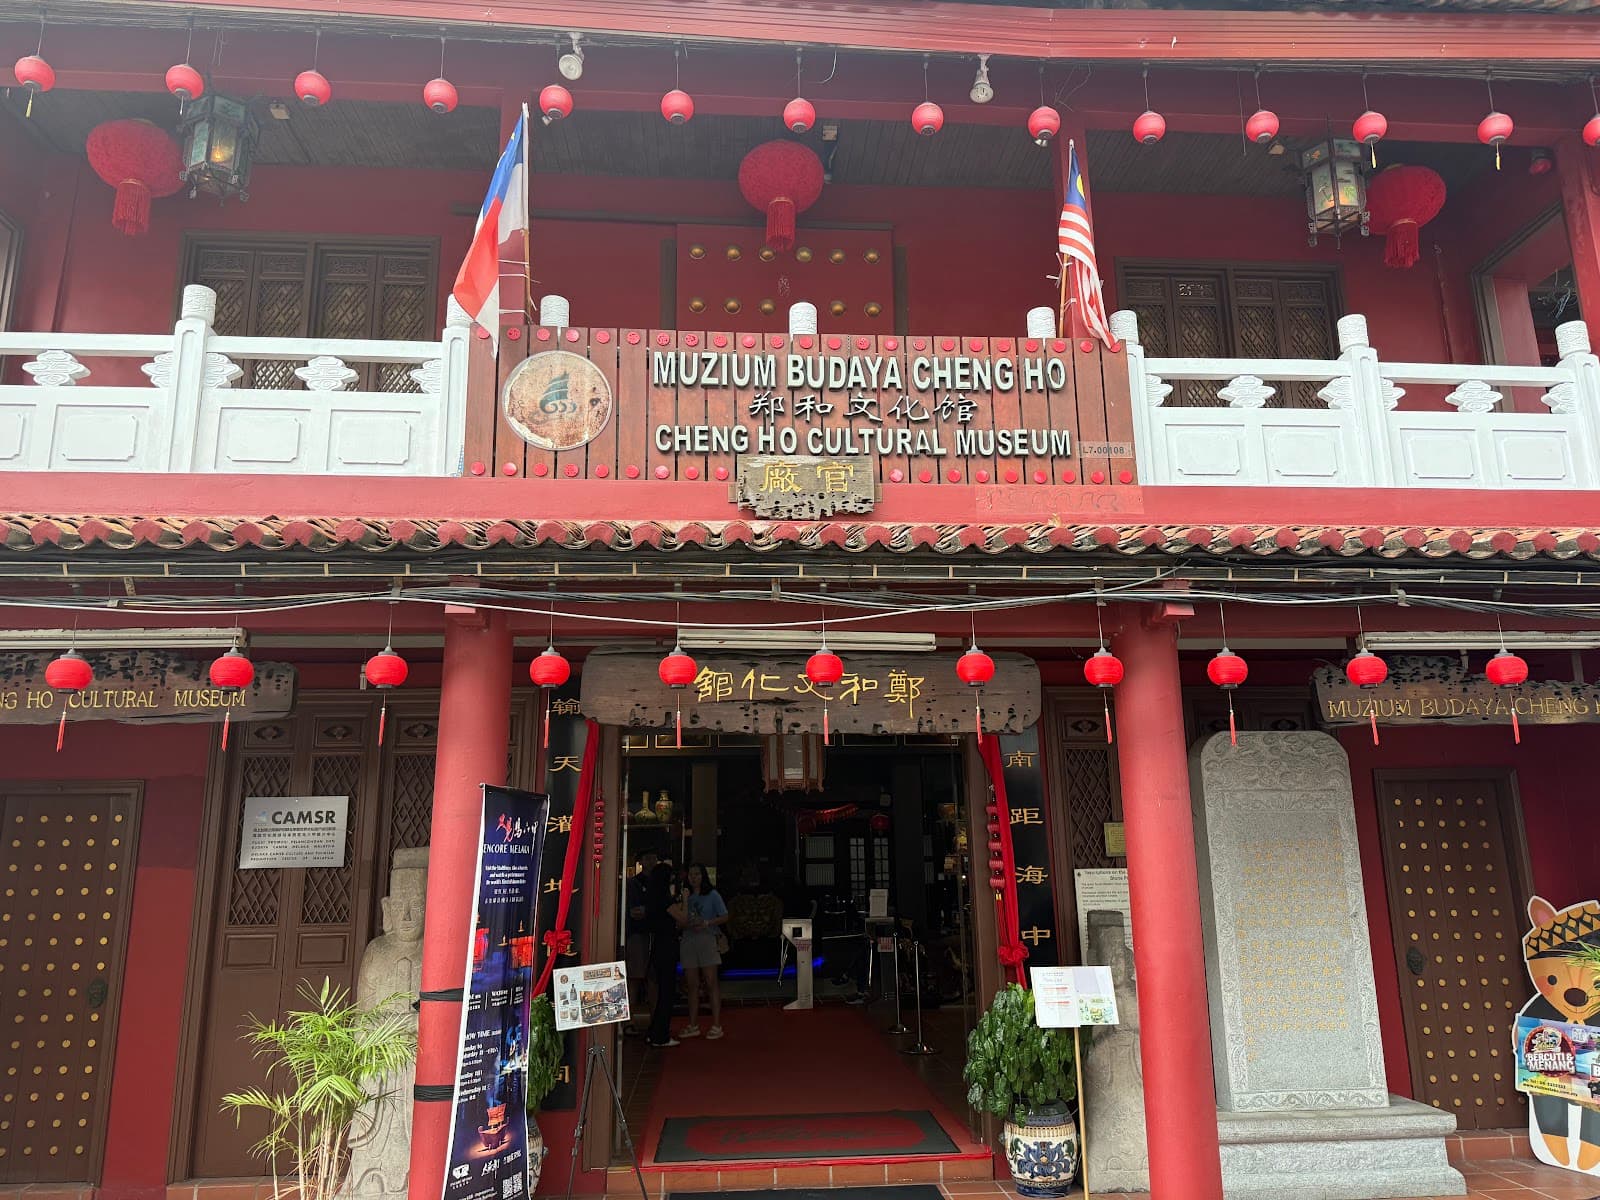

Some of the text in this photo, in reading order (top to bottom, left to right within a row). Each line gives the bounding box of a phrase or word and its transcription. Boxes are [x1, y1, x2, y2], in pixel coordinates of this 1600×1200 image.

[653, 351, 1066, 392] MUZIUM BUDAYA CHENG HO
[749, 391, 978, 424] 郑和文化馆
[655, 424, 1072, 457] CHENG HO CULTURAL MUSEUM
[26, 690, 54, 709] HO
[68, 689, 159, 709] CULTURAL
[174, 689, 247, 708] MUSEUM
[1327, 699, 1412, 718] MUZIUM
[1420, 698, 1512, 717] BUDAYA
[1514, 697, 1590, 716] CHENG
[271, 810, 336, 824] CAMSR
[483, 843, 508, 854] ENCORE
[1526, 1053, 1575, 1061] BERCUTI &
[1527, 1061, 1575, 1073] MENANG
